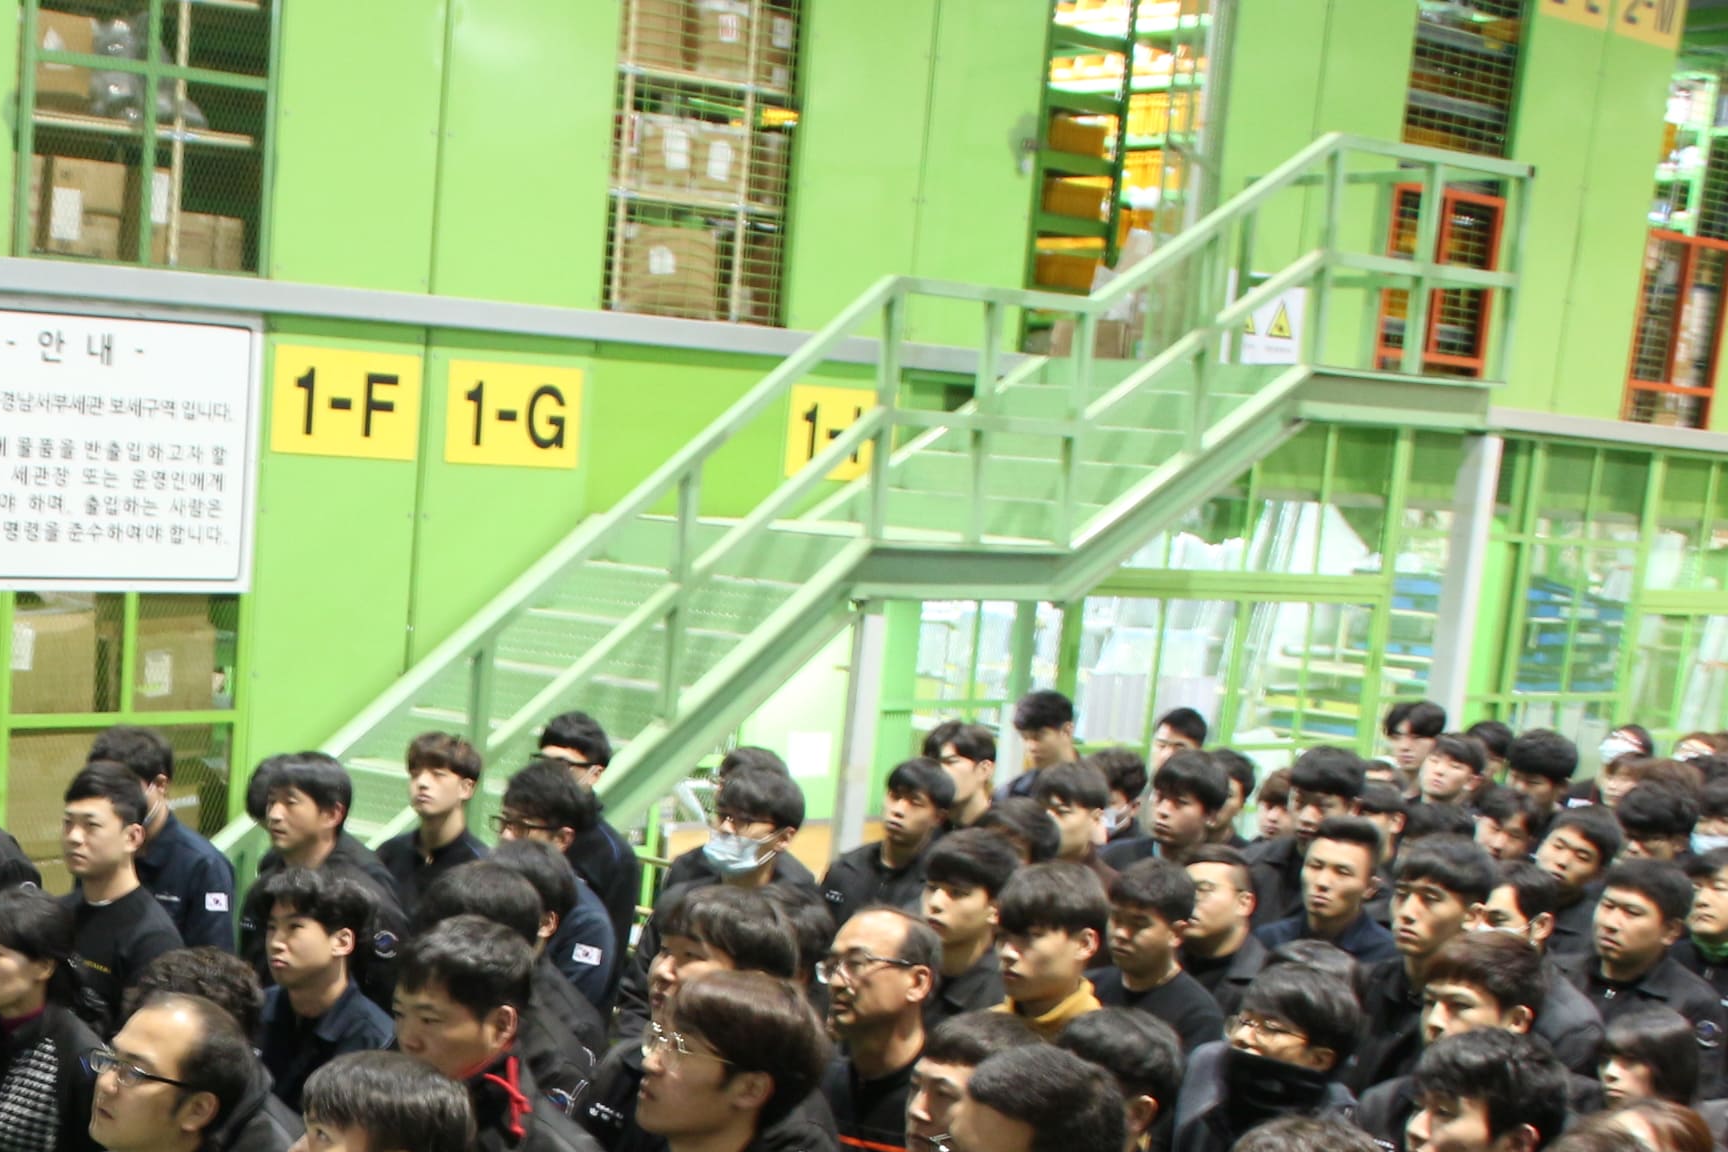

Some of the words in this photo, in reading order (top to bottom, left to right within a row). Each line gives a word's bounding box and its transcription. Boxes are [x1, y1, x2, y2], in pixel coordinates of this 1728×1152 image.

[0, 390, 103, 416] 경남서부세관
[110, 394, 175, 419] 보세구역
[296, 366, 399, 437] 1-F
[466, 380, 565, 449] 1-G
[18, 436, 73, 460] 물품을
[84, 440, 203, 464] 반출입하고자
[212, 445, 226, 466] 할
[11, 465, 69, 488] 세관장
[82, 467, 118, 488] 또는
[86, 494, 159, 517] 출입하는
[170, 498, 222, 519] 사람은
[4, 521, 59, 542] 명령을
[68, 522, 162, 544] 준수하여야
